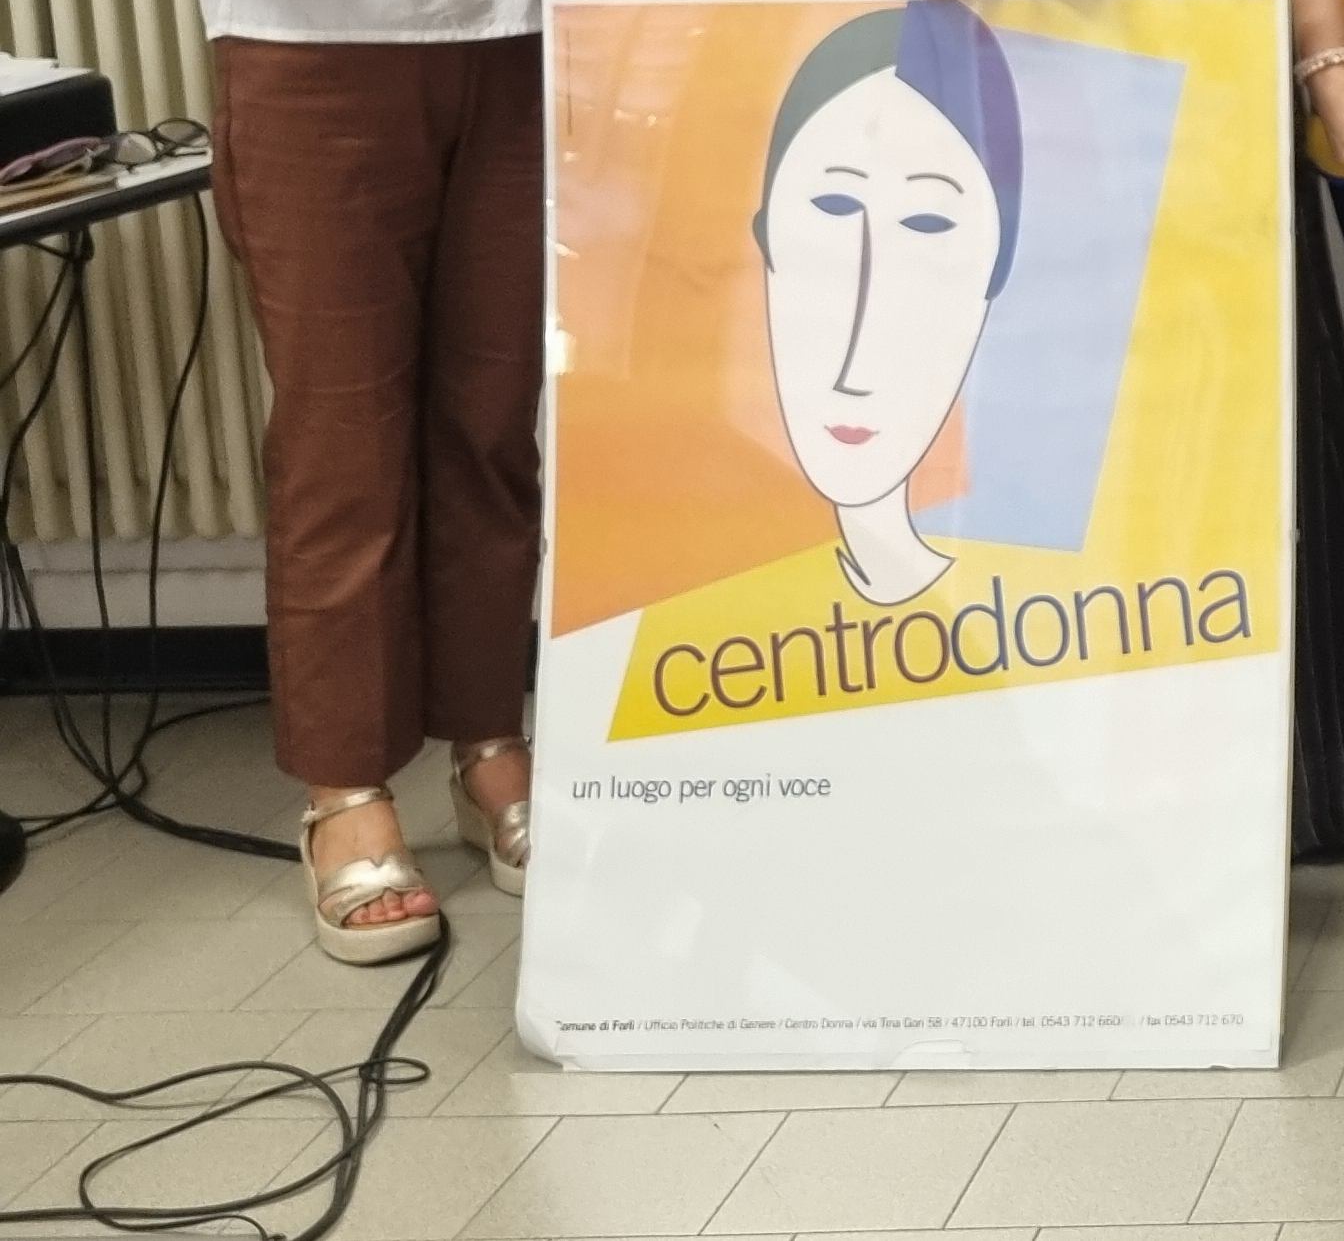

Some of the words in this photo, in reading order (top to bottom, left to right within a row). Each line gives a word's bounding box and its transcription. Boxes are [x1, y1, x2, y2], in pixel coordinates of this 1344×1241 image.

[652, 568, 1253, 718] centrodonna
[572, 780, 601, 800] un
[610, 775, 672, 803] luogo
[679, 779, 717, 804] per
[723, 773, 771, 802] ogni
[779, 777, 832, 797] voce
[600, 1020, 610, 1031] di
[681, 1019, 725, 1030] Politiche
[785, 1018, 819, 1029] Centro
[821, 1018, 854, 1029] Donna
